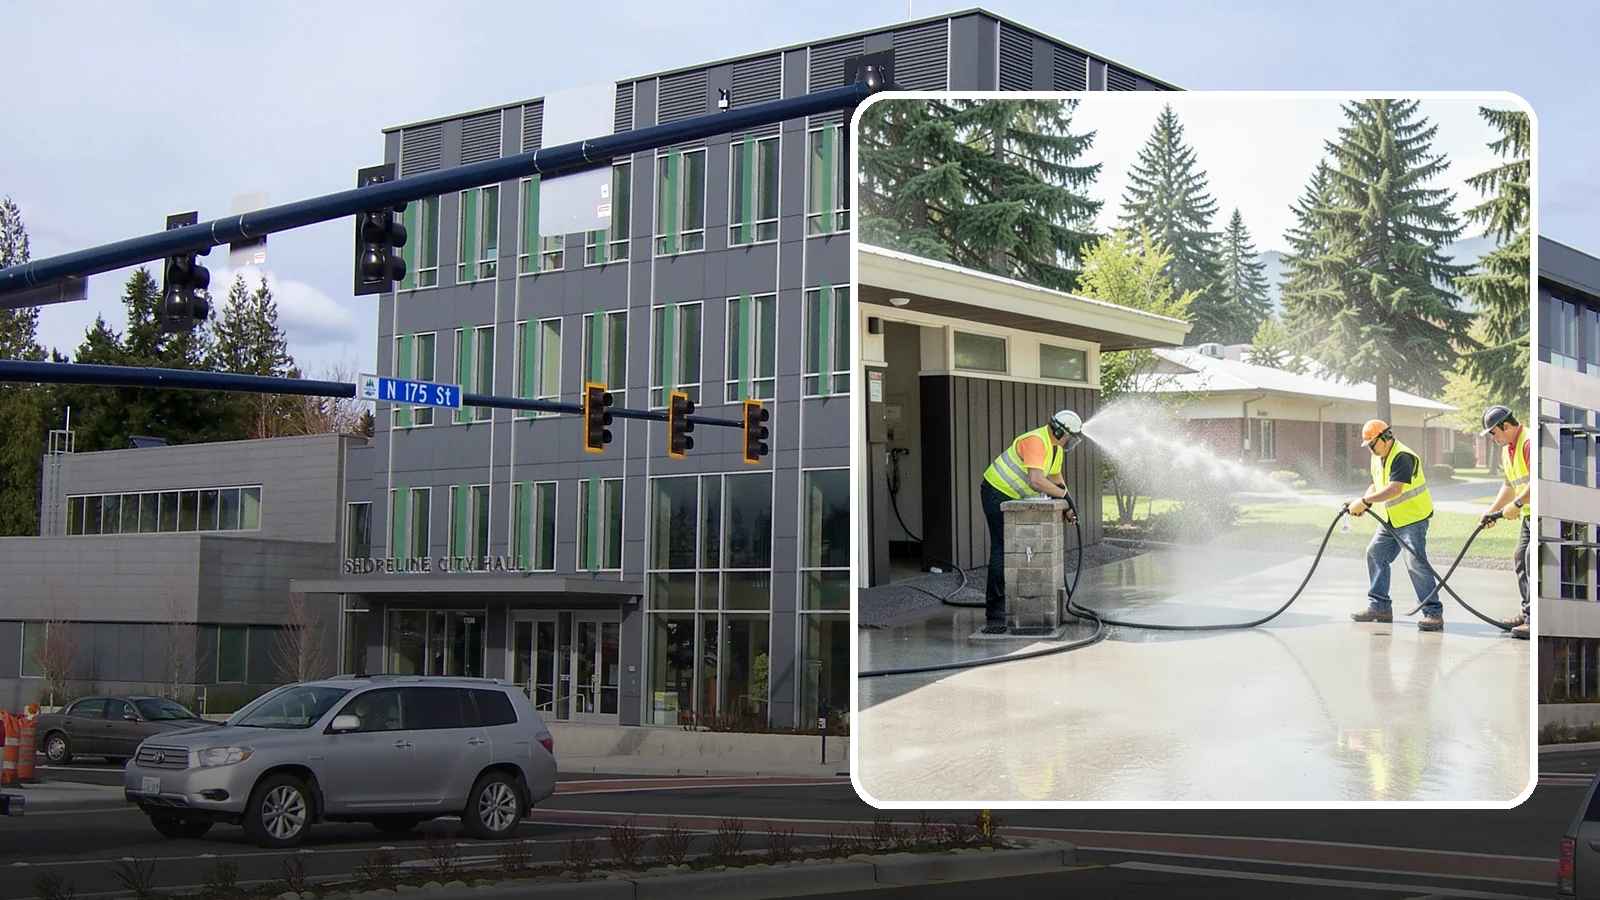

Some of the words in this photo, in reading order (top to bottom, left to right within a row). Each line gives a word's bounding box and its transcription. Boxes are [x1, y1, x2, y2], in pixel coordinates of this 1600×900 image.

[387, 381, 396, 400] N
[405, 383, 427, 403] 175
[436, 387, 451, 406] St
[344, 557, 432, 574] SHORELINE
[438, 556, 476, 572] CITY
[484, 556, 526, 571] HALL
